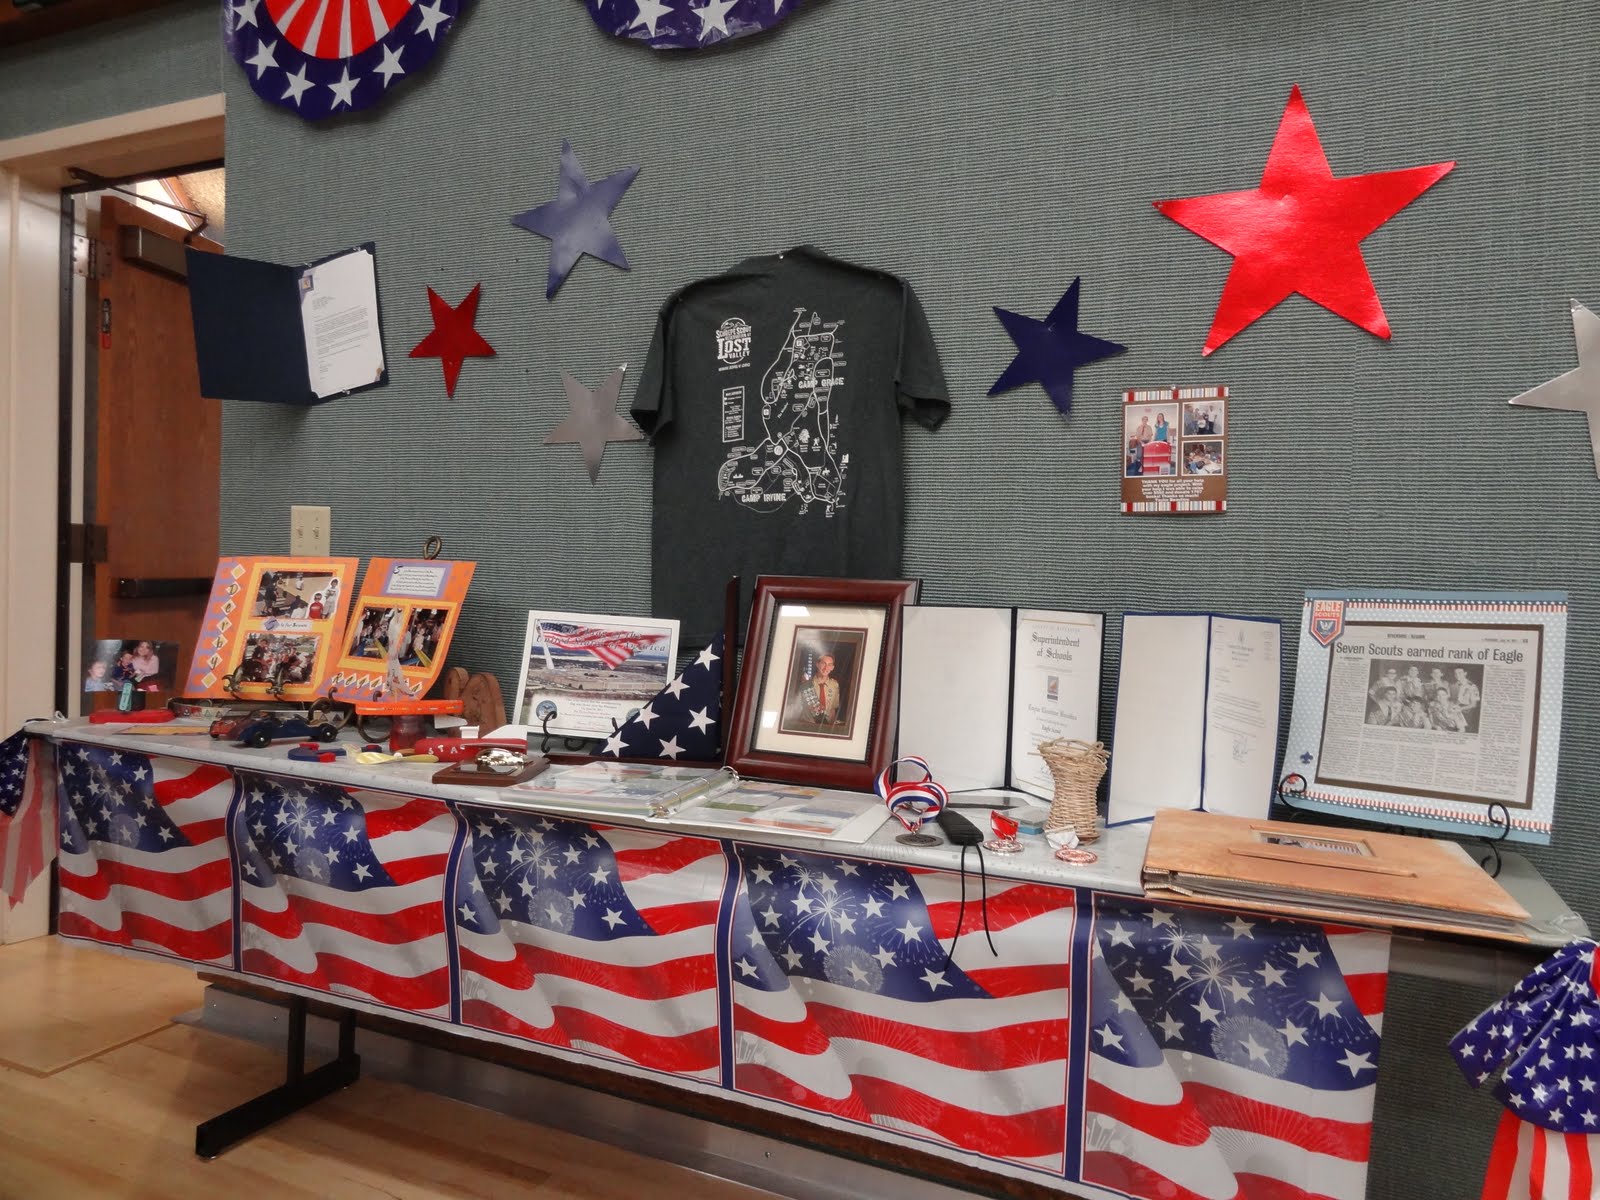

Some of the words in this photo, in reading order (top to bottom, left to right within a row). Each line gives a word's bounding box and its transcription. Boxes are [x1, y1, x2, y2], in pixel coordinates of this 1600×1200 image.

[736, 326, 752, 334] SCOUT
[716, 337, 752, 360] LOST
[728, 350, 750, 359] VALLEY
[741, 494, 760, 502] CAMP
[764, 493, 787, 502] IRVINE
[1316, 601, 1342, 612] EAGLE
[1032, 632, 1080, 648] Superintendent
[1036, 648, 1043, 656] of
[1046, 647, 1073, 662] Schools
[1336, 642, 1364, 654] Seven
[1369, 643, 1403, 656] Scouts
[1407, 645, 1445, 658] earned
[1448, 648, 1473, 659] rank
[1478, 648, 1490, 660] of
[1493, 649, 1523, 664] Eagle
